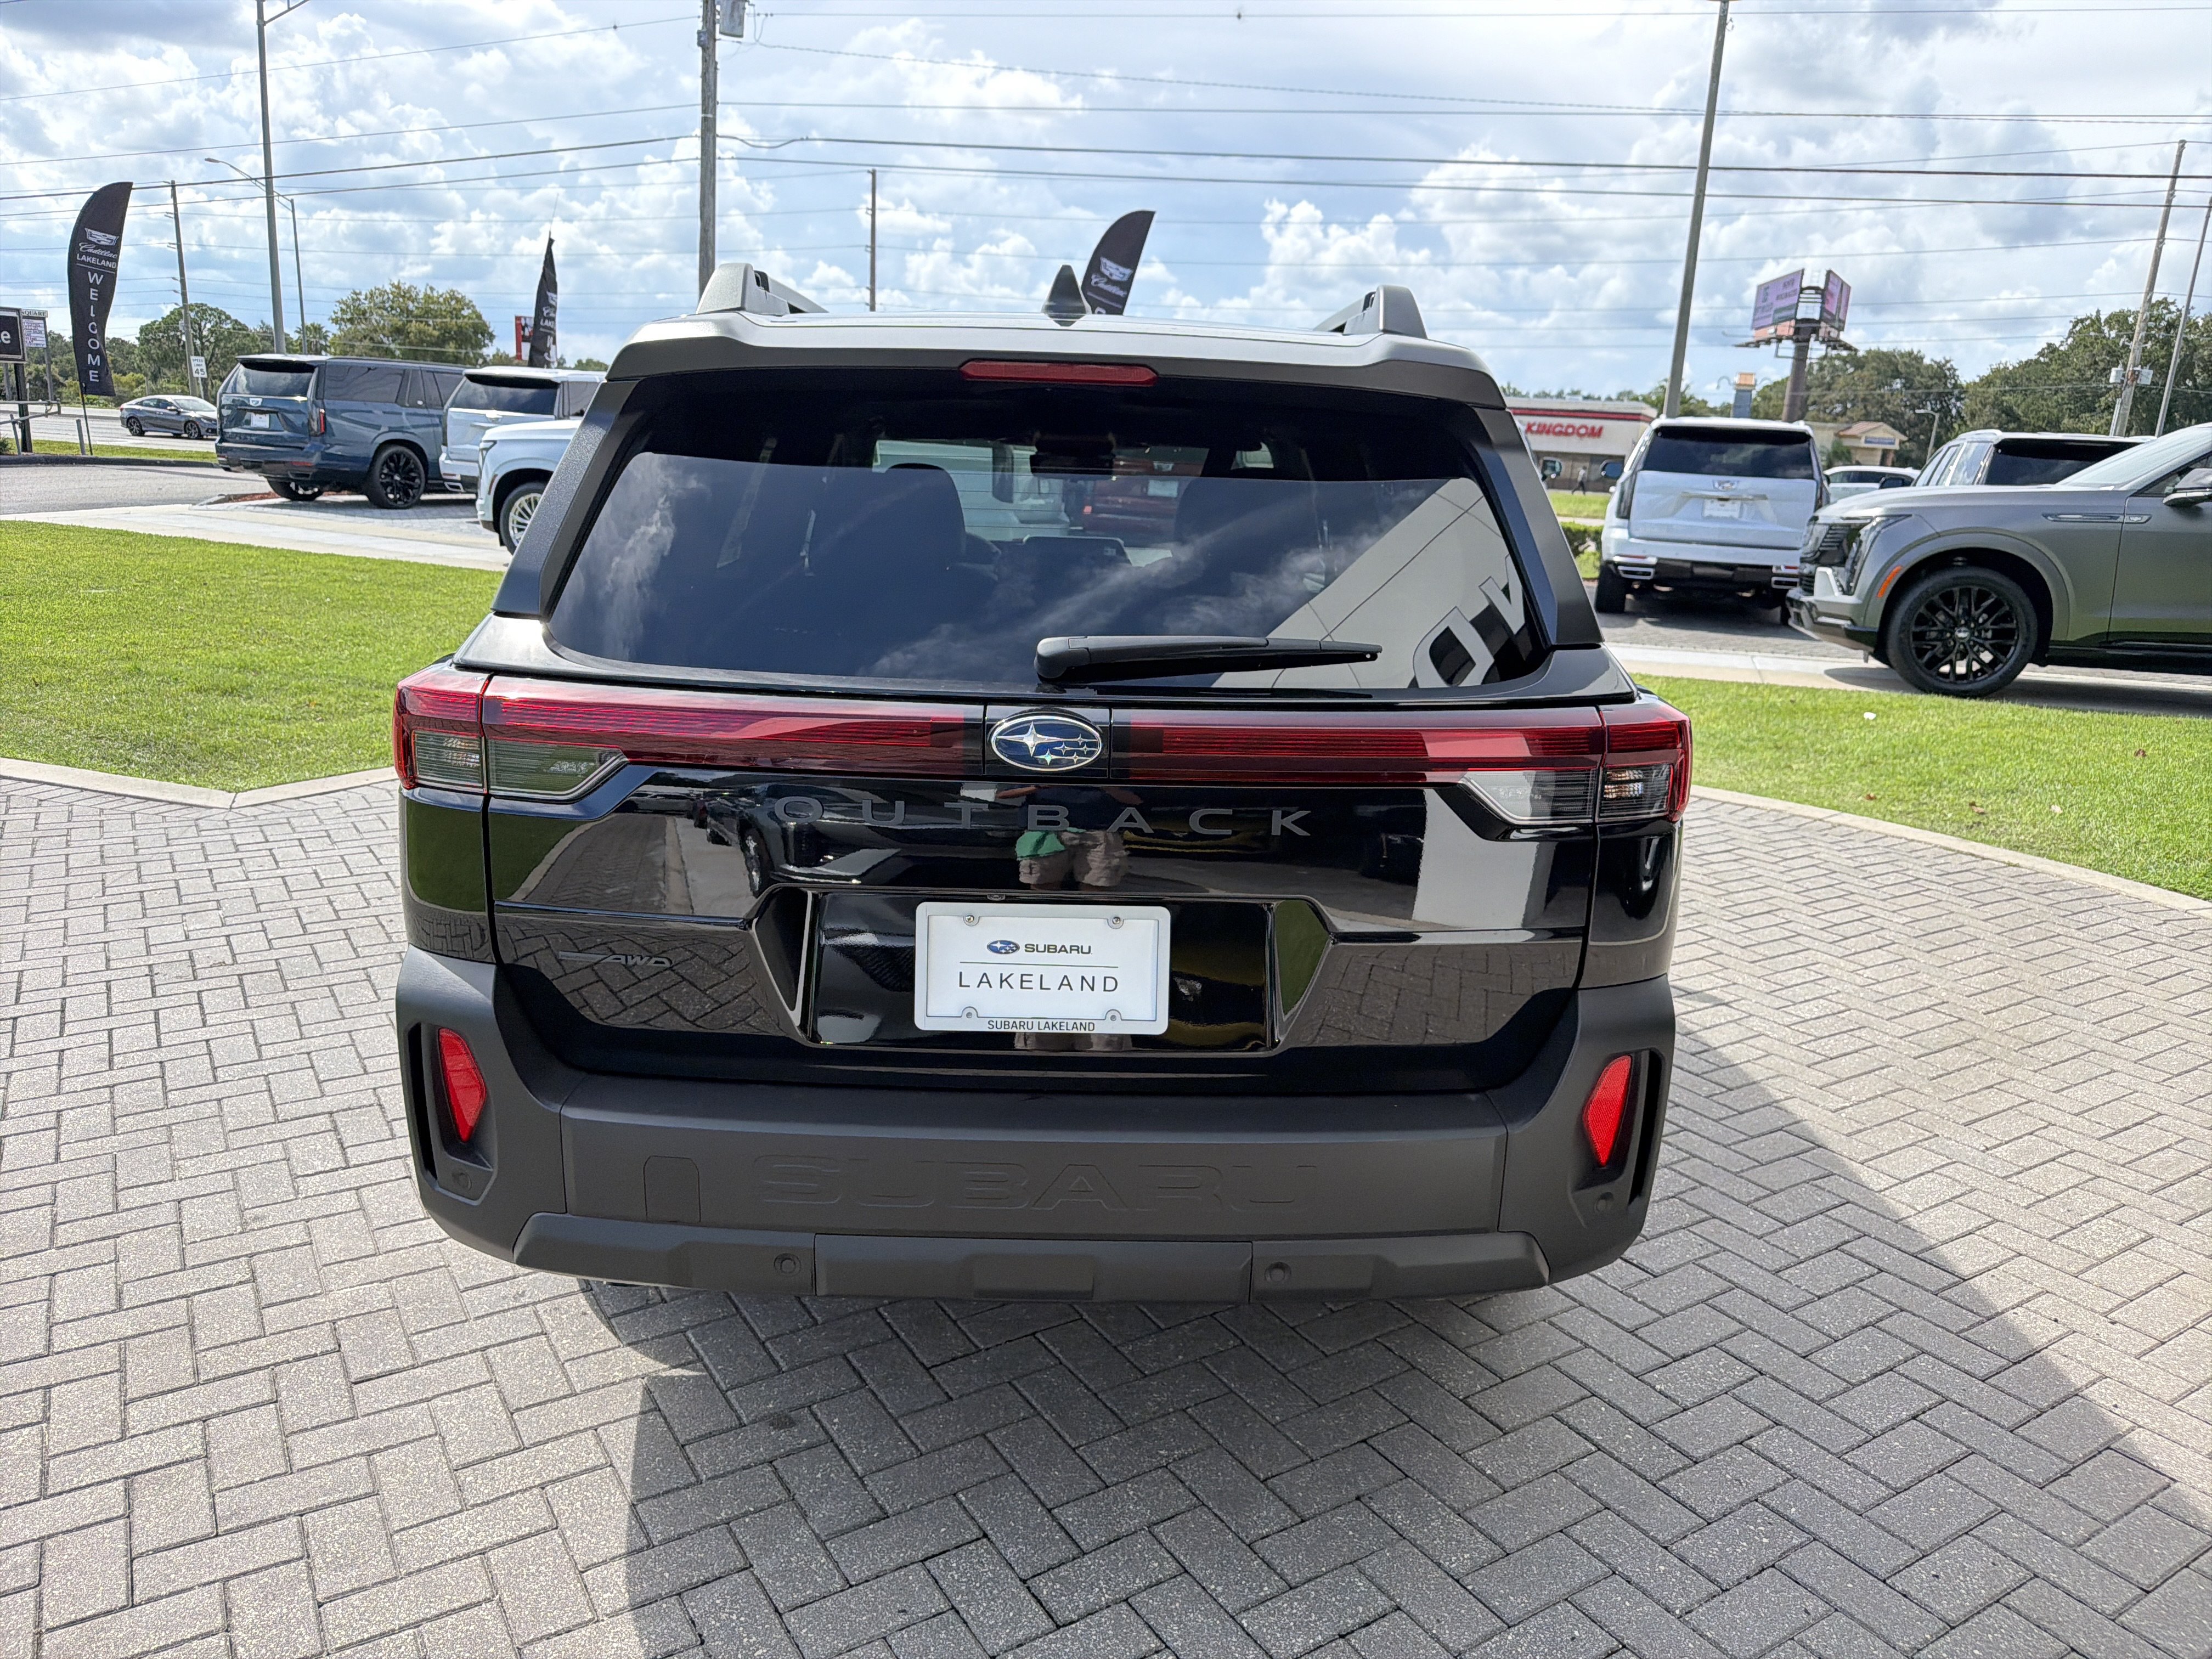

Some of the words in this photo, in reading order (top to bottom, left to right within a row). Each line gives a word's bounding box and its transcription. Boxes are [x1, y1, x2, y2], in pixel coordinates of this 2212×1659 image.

[77, 253, 116, 268] LAKELAND
[88, 271, 103, 382] WELCOME
[1525, 422, 1604, 438] KINGDOM
[774, 796, 1311, 837] OUTBACK
[1024, 943, 1092, 955] SUBARU
[601, 953, 673, 967] AWD
[958, 971, 1119, 992] LAKELAND
[987, 1020, 1034, 1031] SUBARU
[1037, 1021, 1095, 1032] LAKELAND
[753, 1154, 1317, 1211] SUBARU
